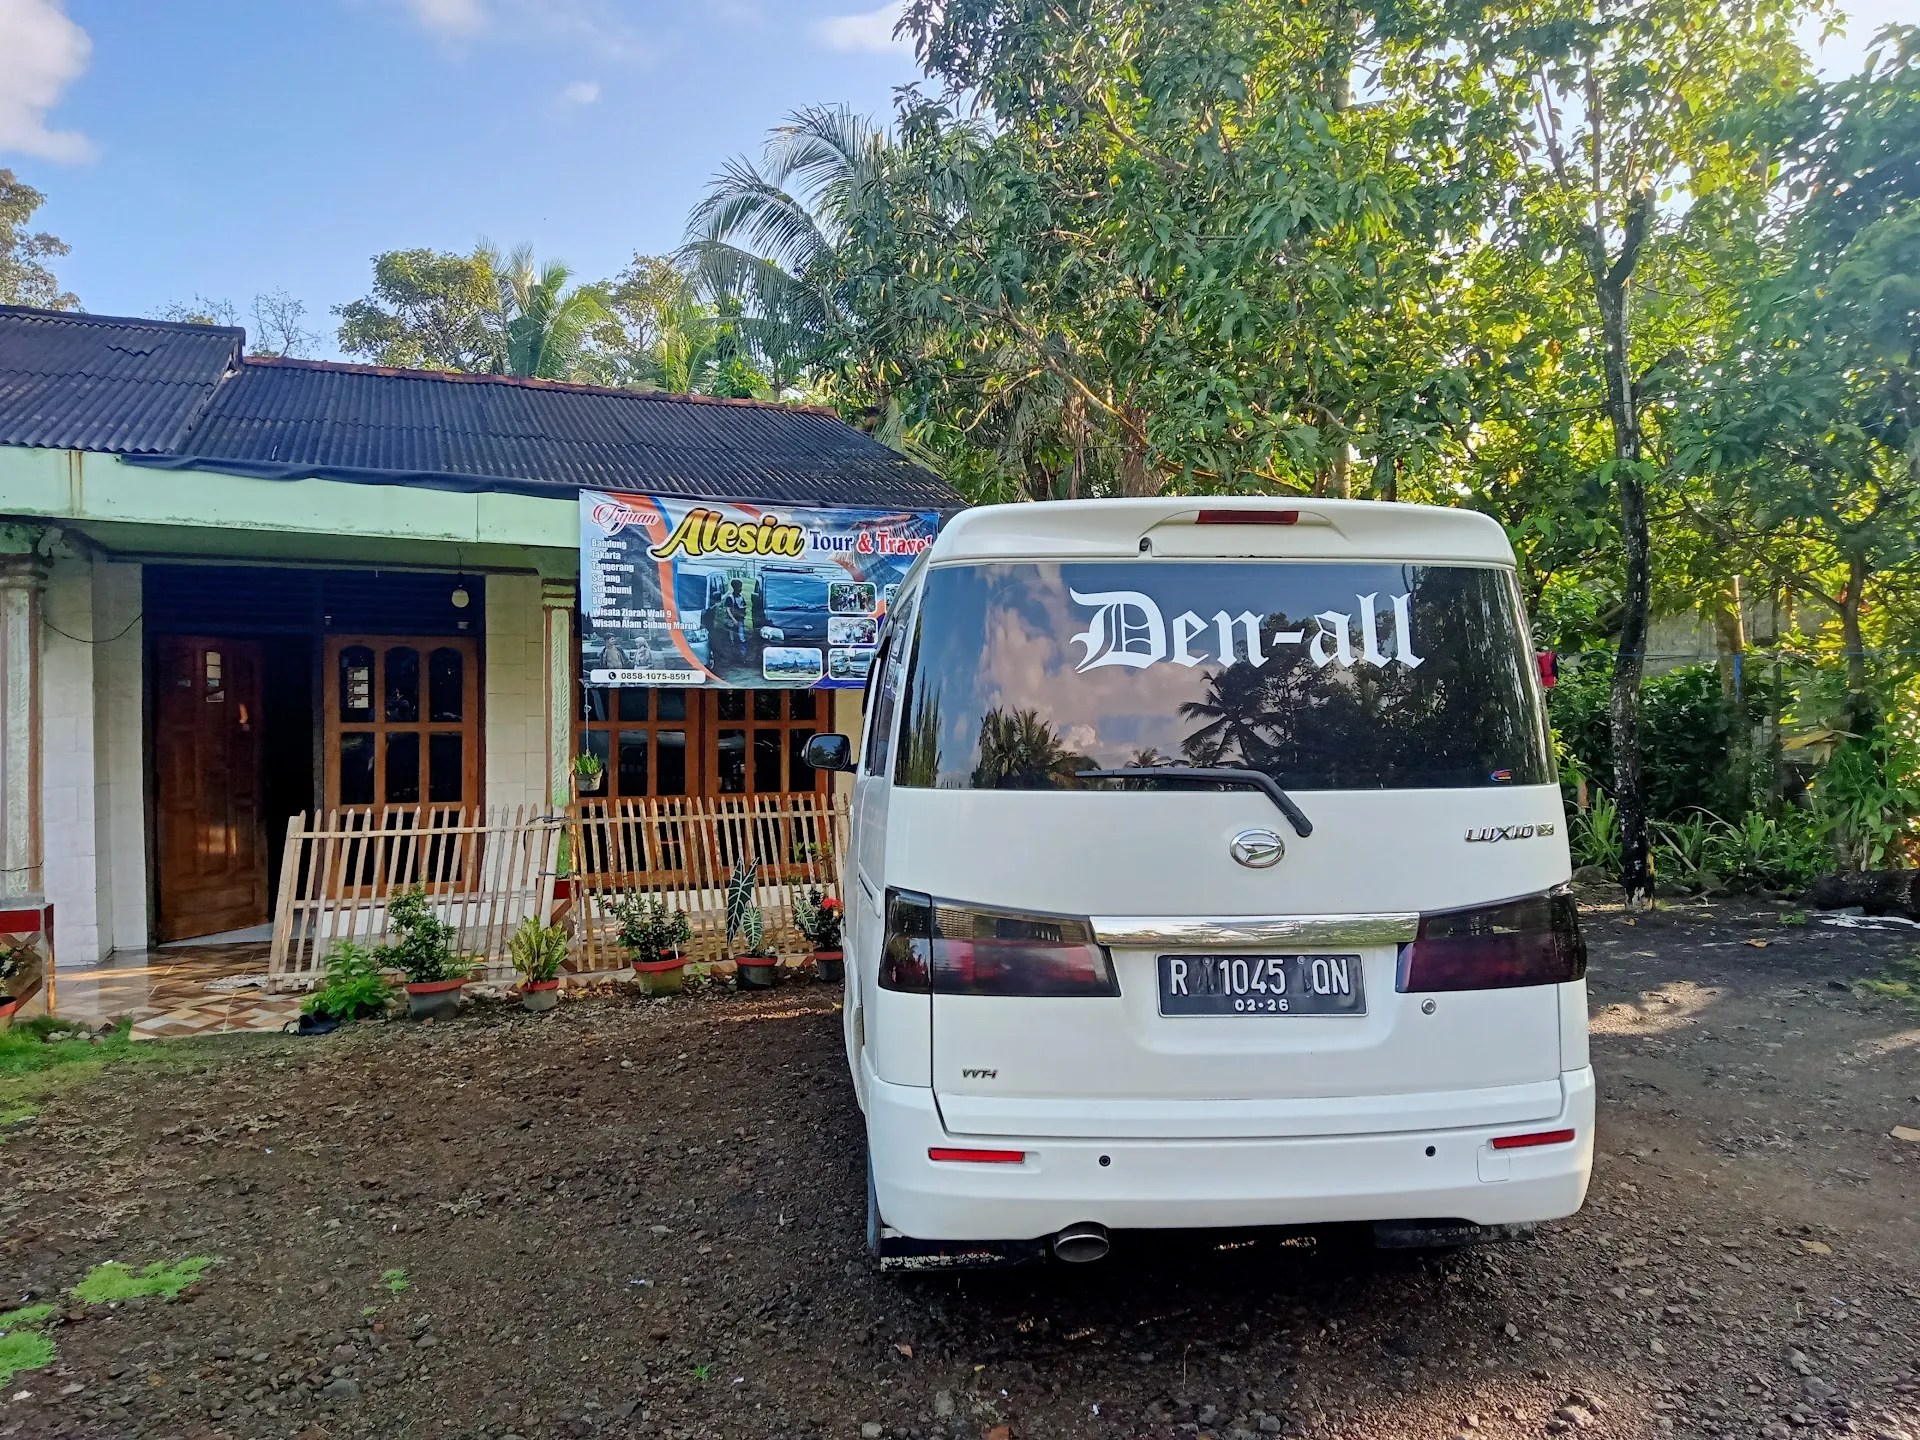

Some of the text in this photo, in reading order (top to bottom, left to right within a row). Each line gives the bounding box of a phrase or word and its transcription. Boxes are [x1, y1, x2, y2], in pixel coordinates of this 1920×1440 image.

[592, 503, 659, 534] Tujuan
[650, 508, 805, 558] Alesia
[809, 530, 853, 551] Tour
[858, 532, 873, 553] &
[591, 538, 628, 550] Bandung
[591, 550, 621, 560] Jakarta
[591, 560, 635, 573] Tangerang
[592, 573, 621, 584] Serang
[592, 584, 633, 595] Sukabumi
[592, 596, 617, 606] Bogor
[592, 607, 672, 619] Wisata Ziarah Wali 9
[592, 618, 699, 631] Wisata Alam Subang Maruk
[1069, 586, 1426, 674] Den-all
[621, 672, 692, 681] 0858-1075-8591
[1465, 823, 1535, 843] LUXIO
[1170, 958, 1350, 996] R 1045 QN
